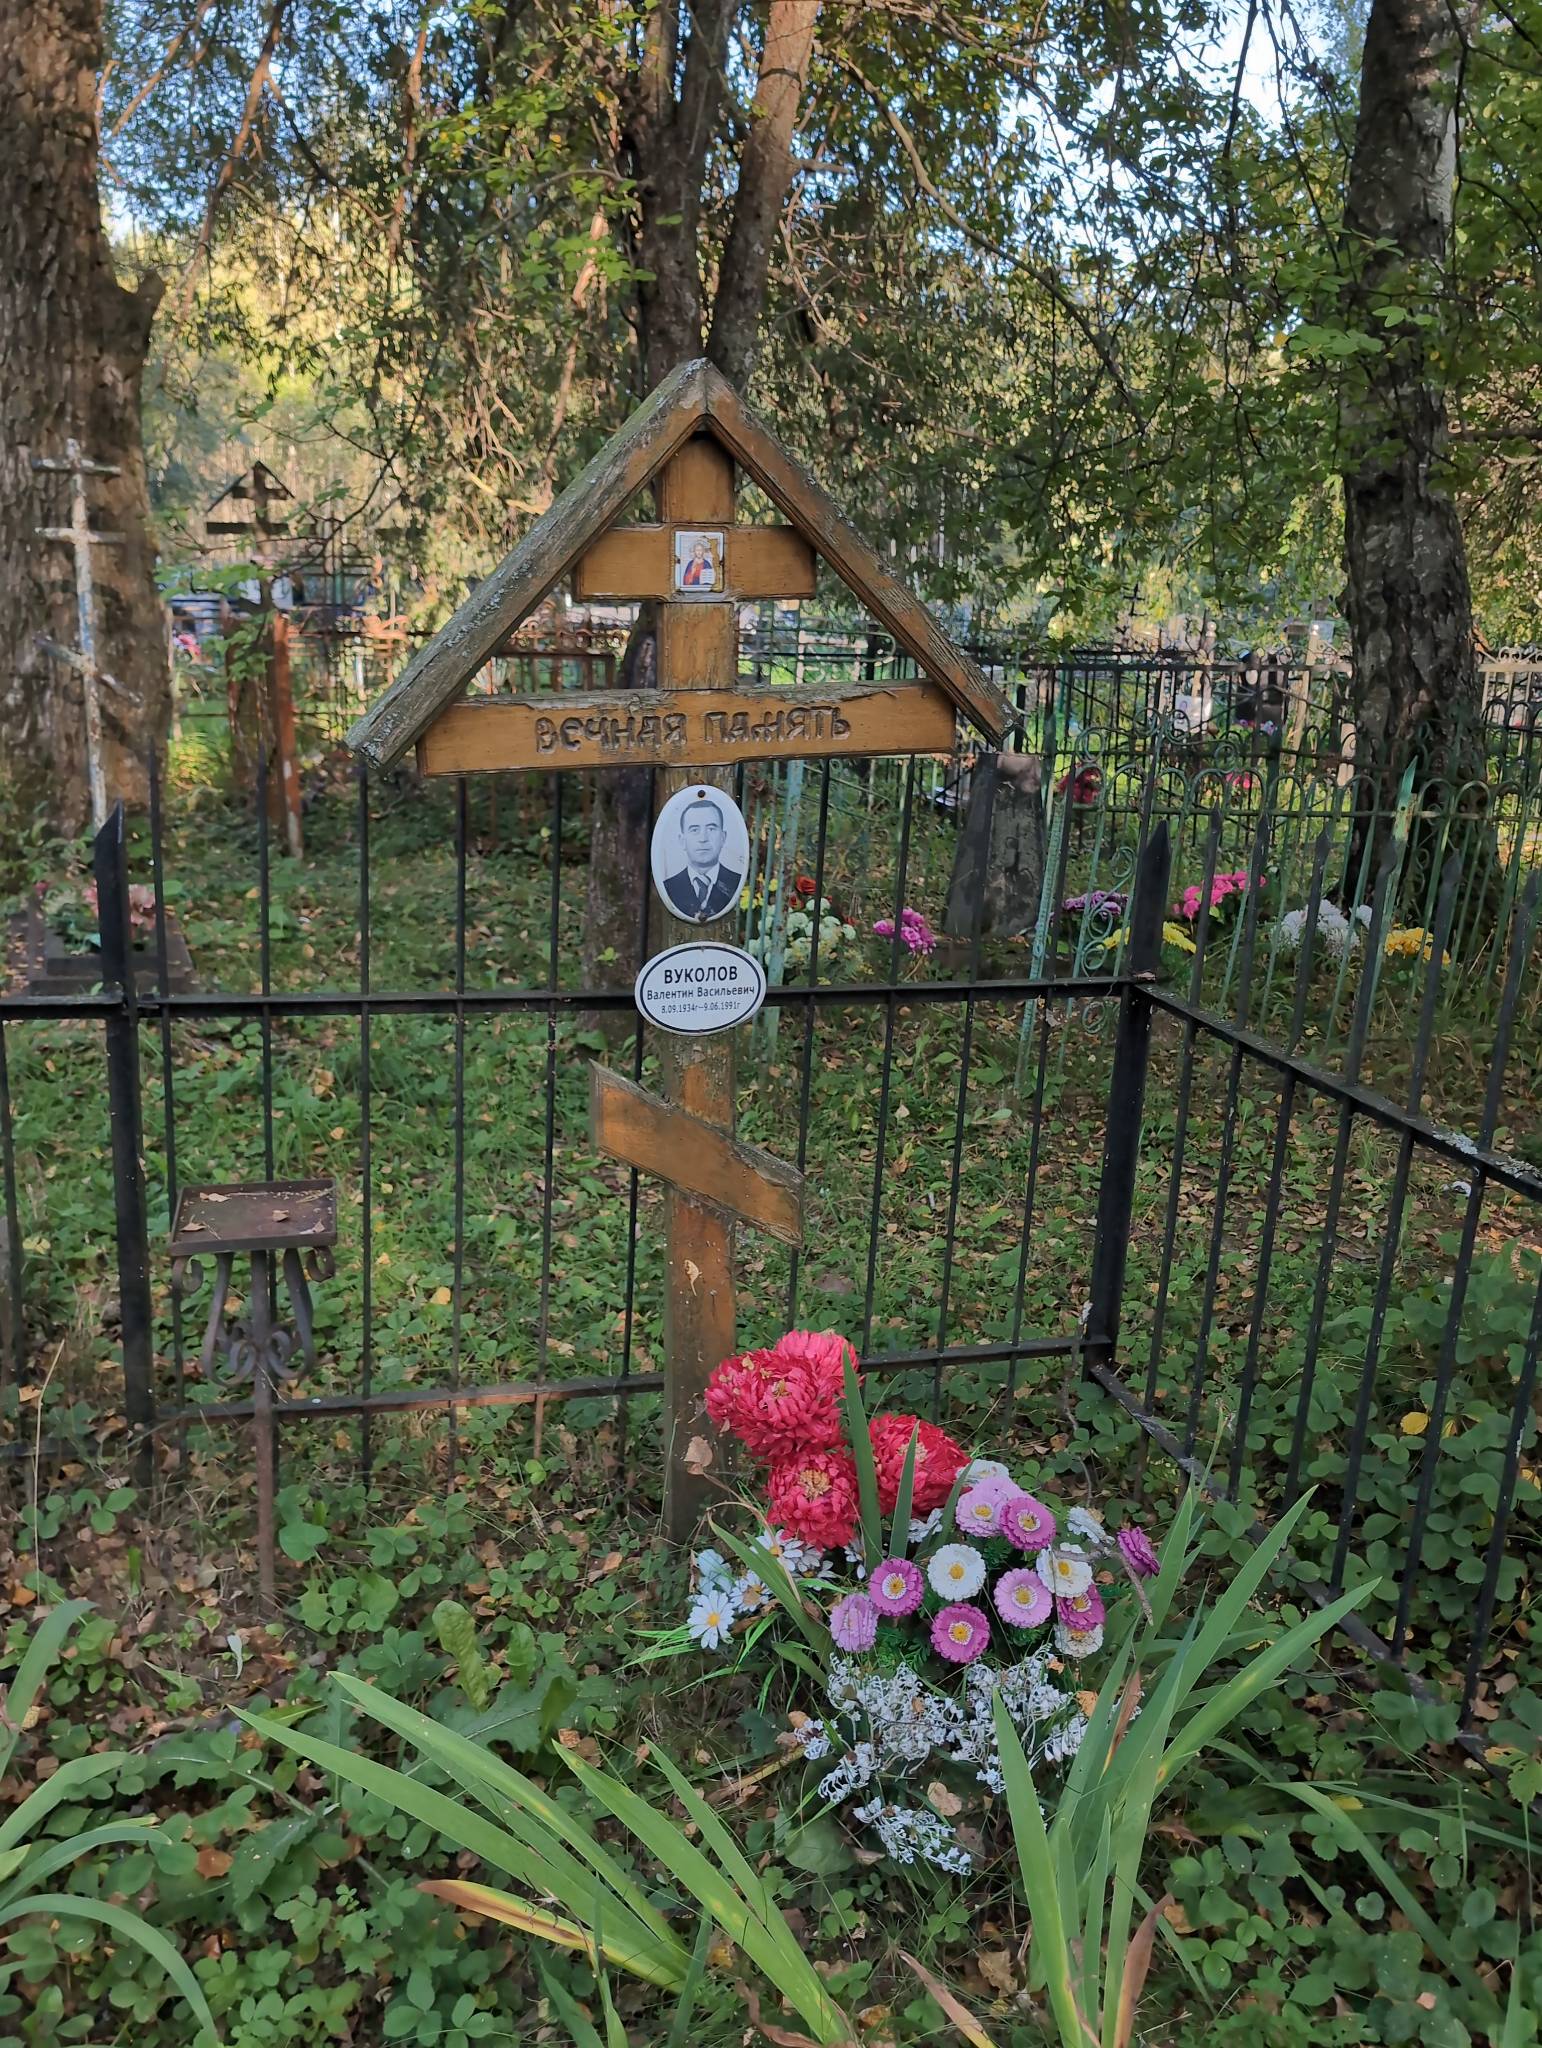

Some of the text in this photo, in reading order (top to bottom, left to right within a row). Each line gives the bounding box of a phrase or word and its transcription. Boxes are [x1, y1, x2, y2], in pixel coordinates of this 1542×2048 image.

[664, 966, 738, 984] ВУКОЛОВ
[647, 986, 755, 1001] Валентин Васильевич
